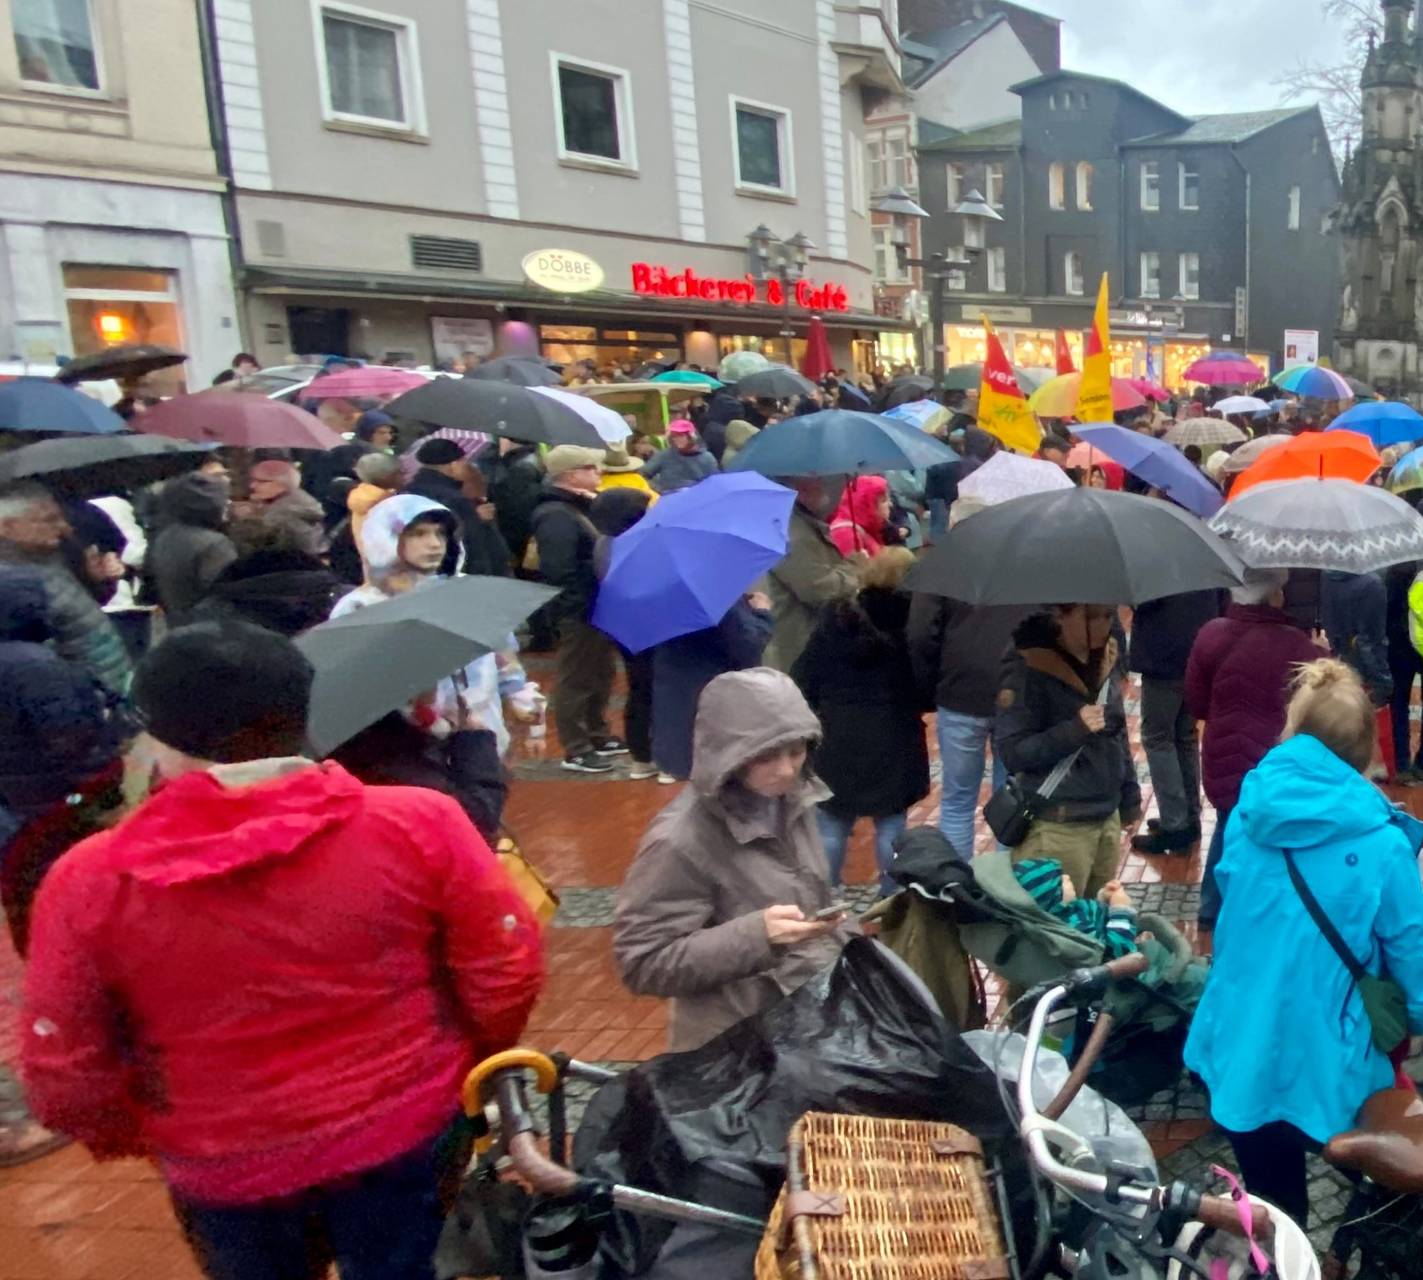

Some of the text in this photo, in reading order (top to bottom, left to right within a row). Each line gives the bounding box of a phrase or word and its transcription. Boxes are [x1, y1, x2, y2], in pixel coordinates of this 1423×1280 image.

[538, 254, 592, 275] DÖBBE
[632, 263, 848, 311] Bäckerei & Café
